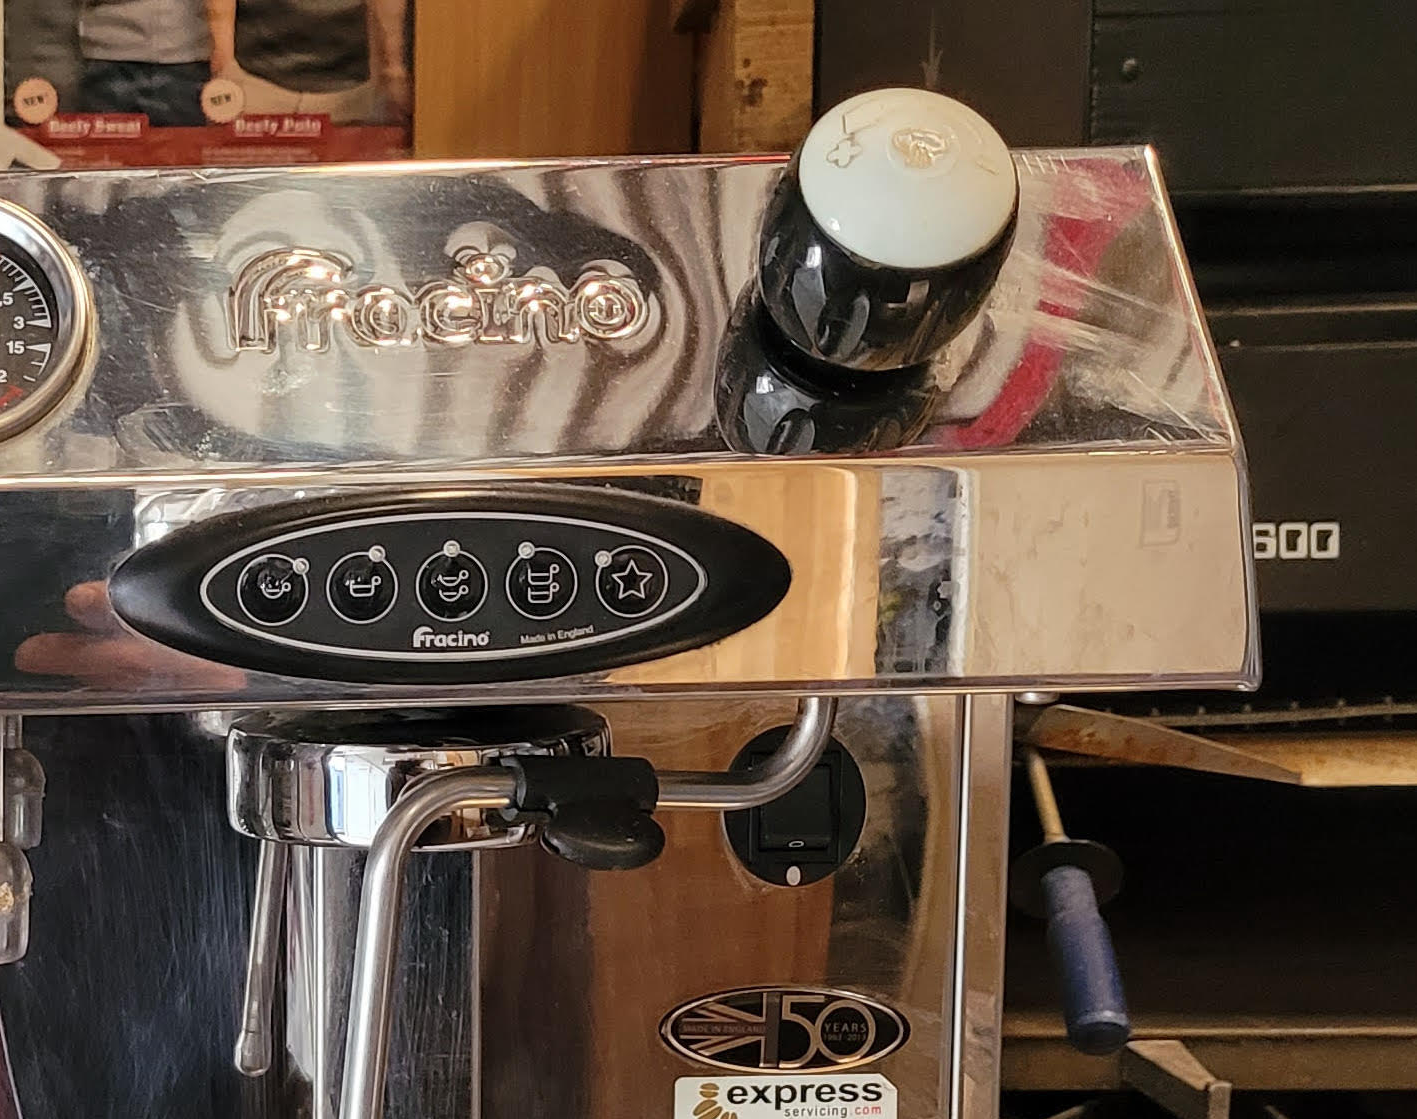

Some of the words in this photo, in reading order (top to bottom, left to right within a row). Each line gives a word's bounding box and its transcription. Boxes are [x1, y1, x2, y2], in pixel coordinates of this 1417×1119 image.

[13, 316, 24, 330] 3
[6, 341, 25, 354] 15
[520, 635, 546, 645] Made
[547, 632, 556, 641] in
[557, 625, 595, 640] England
[682, 1024, 710, 1033] MADE
[711, 1025, 721, 1033] IN
[780, 994, 877, 1070] 50
[824, 1022, 867, 1033] YEARS
[727, 1082, 883, 1110] express
